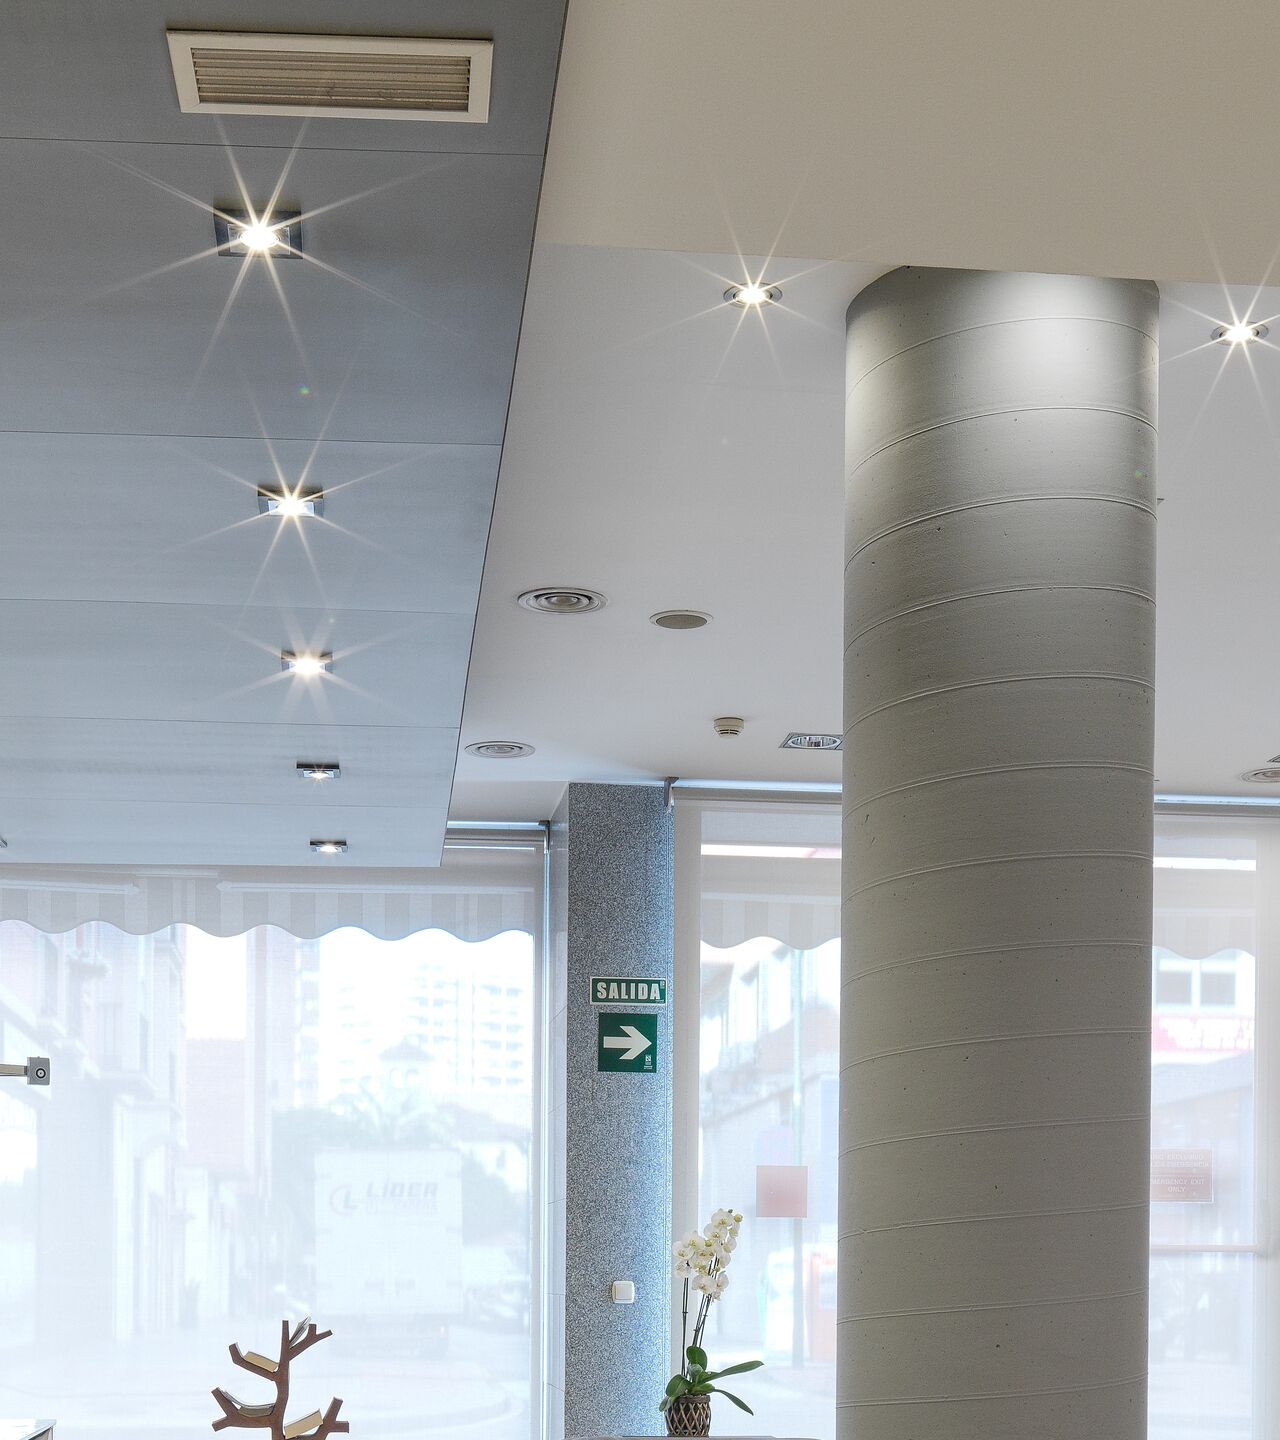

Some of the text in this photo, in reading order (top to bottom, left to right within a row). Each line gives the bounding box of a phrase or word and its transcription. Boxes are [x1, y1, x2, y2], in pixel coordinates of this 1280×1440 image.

[597, 981, 661, 1000] SALIDA
[1190, 1176, 1204, 1185] EXIT
[1167, 1185, 1186, 1193] ONLY
